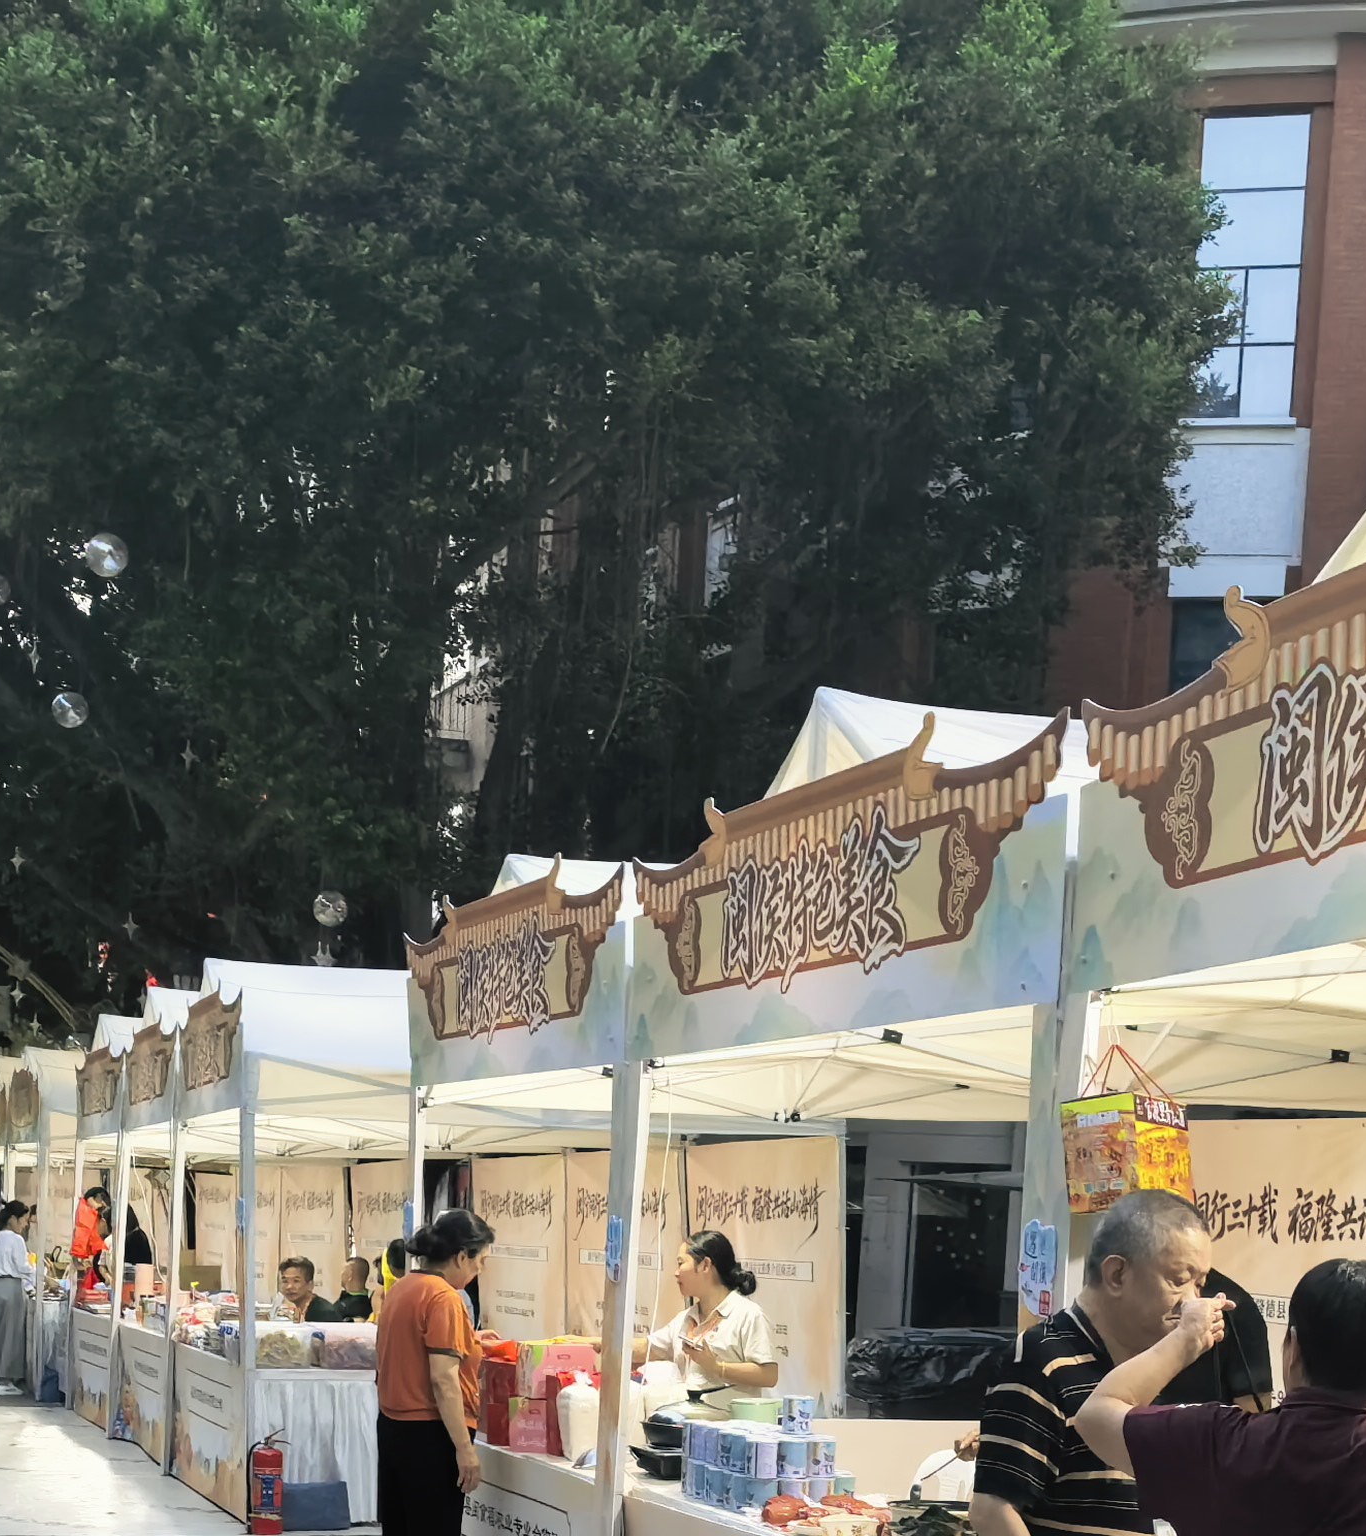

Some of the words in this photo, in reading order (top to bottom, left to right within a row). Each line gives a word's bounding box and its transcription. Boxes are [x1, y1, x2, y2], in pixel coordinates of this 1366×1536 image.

[721, 803, 921, 994] 闽侯特色美食
